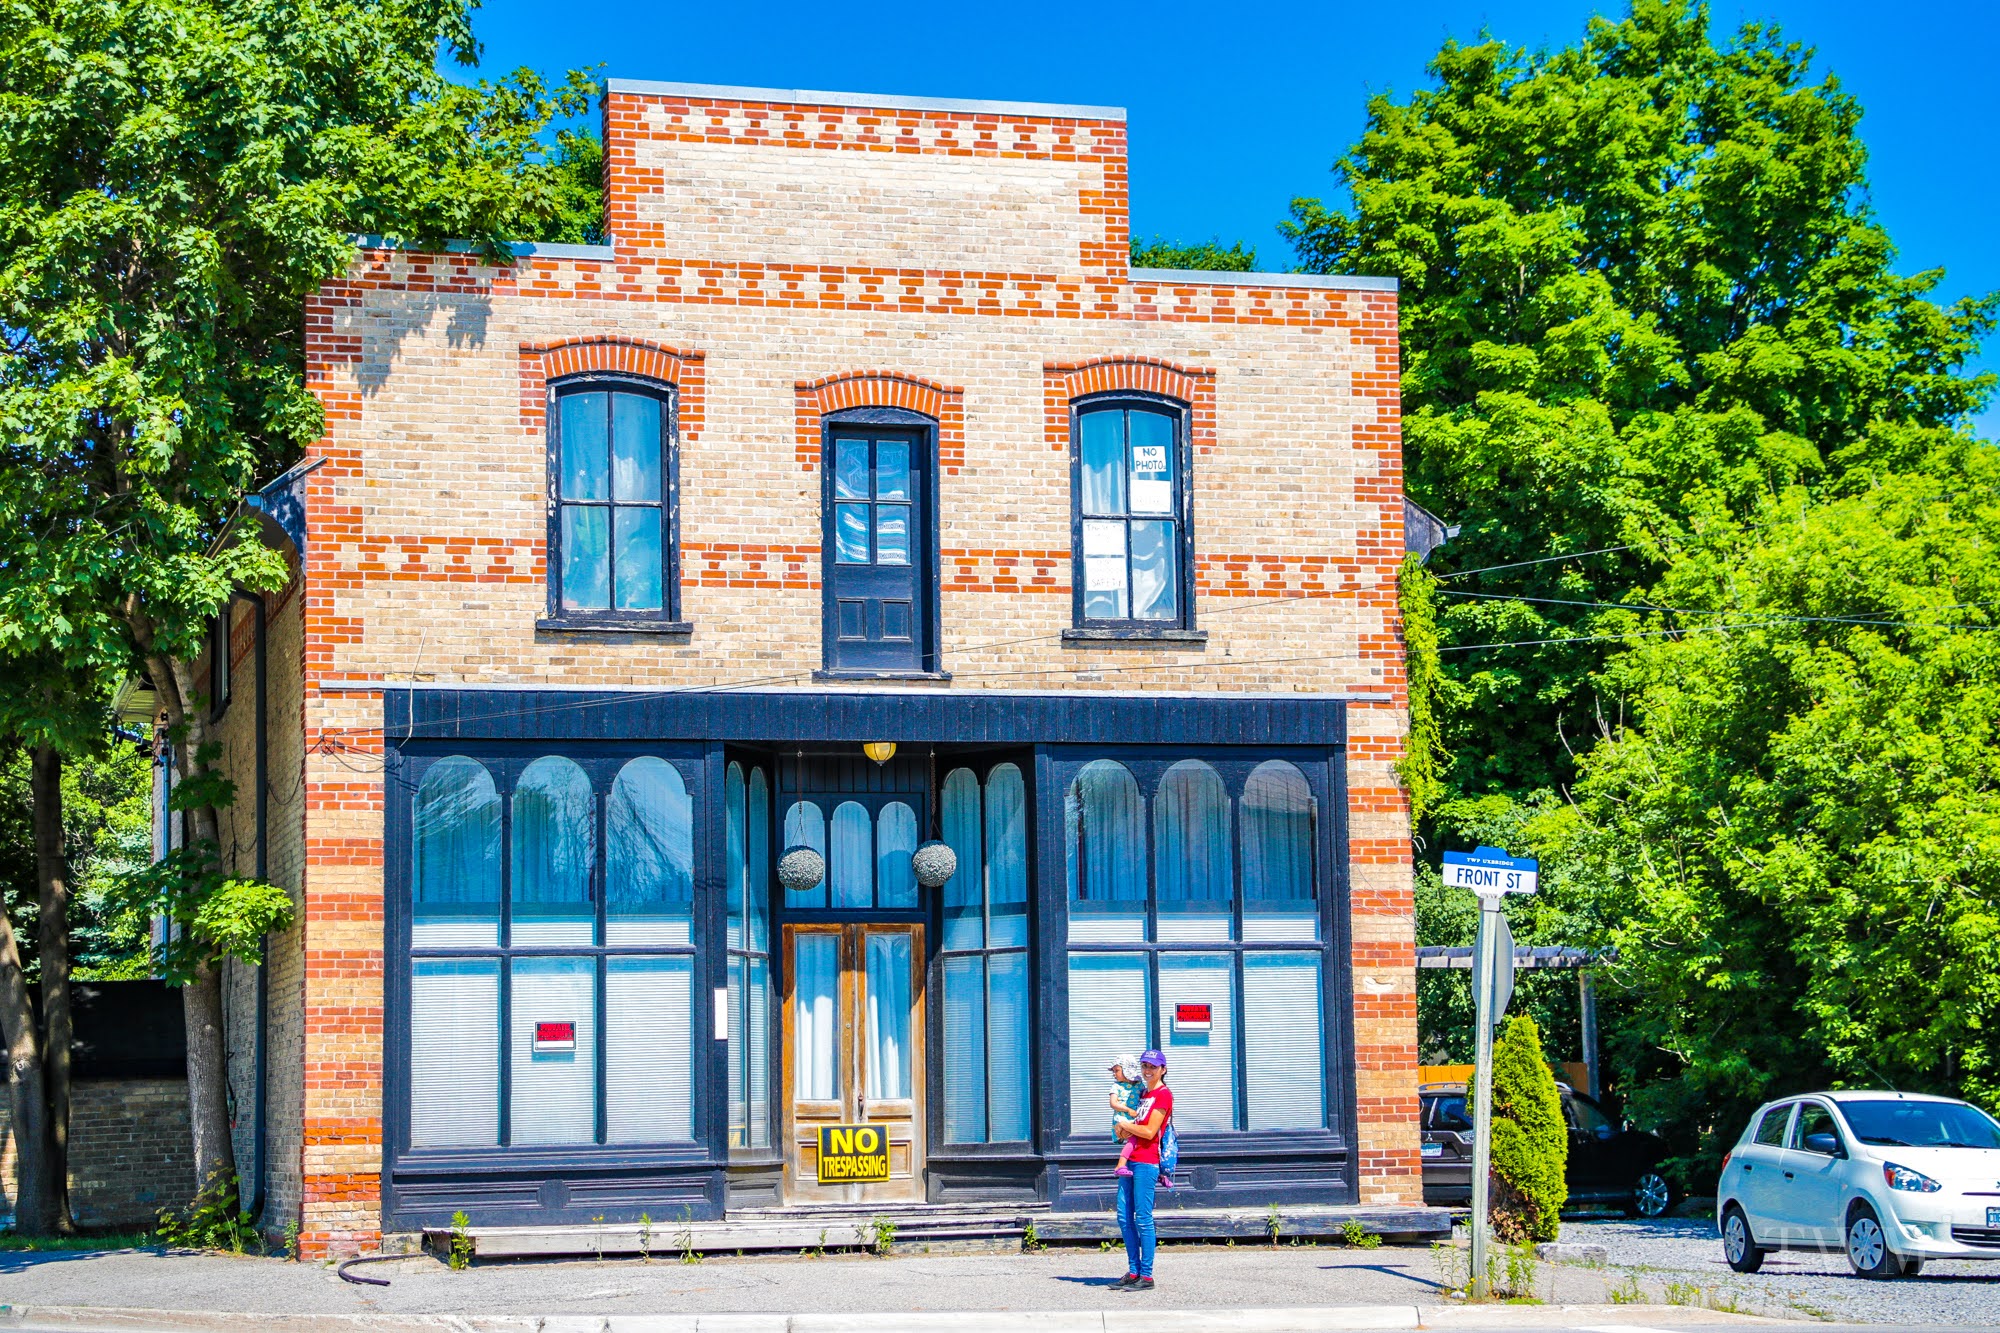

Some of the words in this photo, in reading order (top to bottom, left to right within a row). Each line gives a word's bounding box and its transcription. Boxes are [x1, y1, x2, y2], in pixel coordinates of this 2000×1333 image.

[1143, 447, 1157, 457] NO
[1457, 868, 1500, 887] FRONT
[1506, 872, 1522, 889] ST
[830, 1128, 879, 1154] NO
[823, 1155, 886, 1177] TRESPASSING
